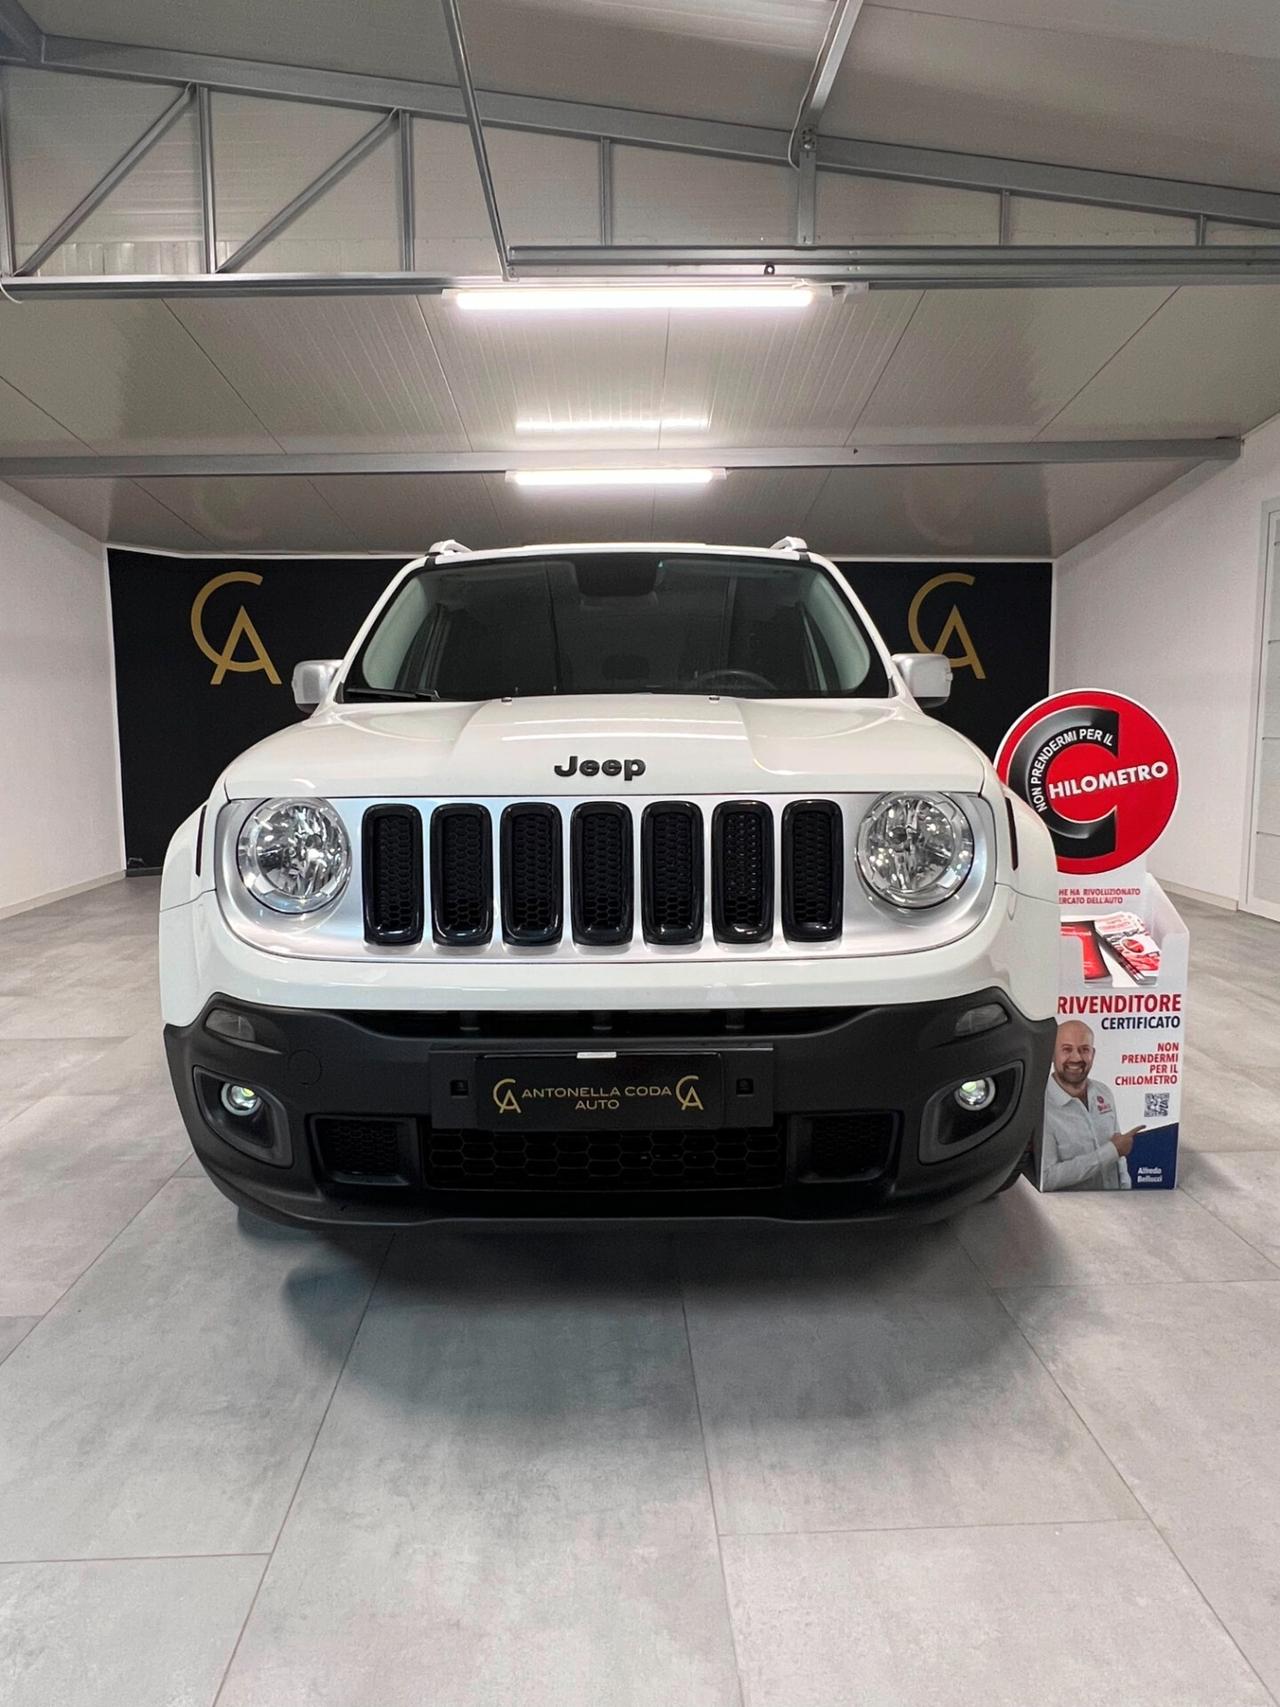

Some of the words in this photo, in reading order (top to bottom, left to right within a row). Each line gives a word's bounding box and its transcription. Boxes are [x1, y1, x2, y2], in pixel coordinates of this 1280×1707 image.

[1079, 728, 1103, 743] PER
[1103, 733, 1114, 747] IL
[1030, 730, 1077, 786] PRENDERMI
[554, 756, 646, 781] Jeep
[1030, 787, 1047, 813] NON
[1070, 888, 1081, 896] HA
[1083, 887, 1141, 896] RIVOLUZIONATO
[1057, 994, 1181, 1015] RIVENDITORE
[1101, 1016, 1181, 1030] CERTIFICATO
[1157, 1042, 1179, 1052] NON
[1121, 1053, 1179, 1064] PRENDERMI
[1150, 1064, 1168, 1074] PER
[1170, 1064, 1179, 1073] IL
[1115, 1075, 1178, 1086] CHILOMETRO
[522, 1087, 621, 1098] ANTONELLA
[624, 1085, 672, 1097] CODA
[575, 1099, 620, 1110] AUTO
